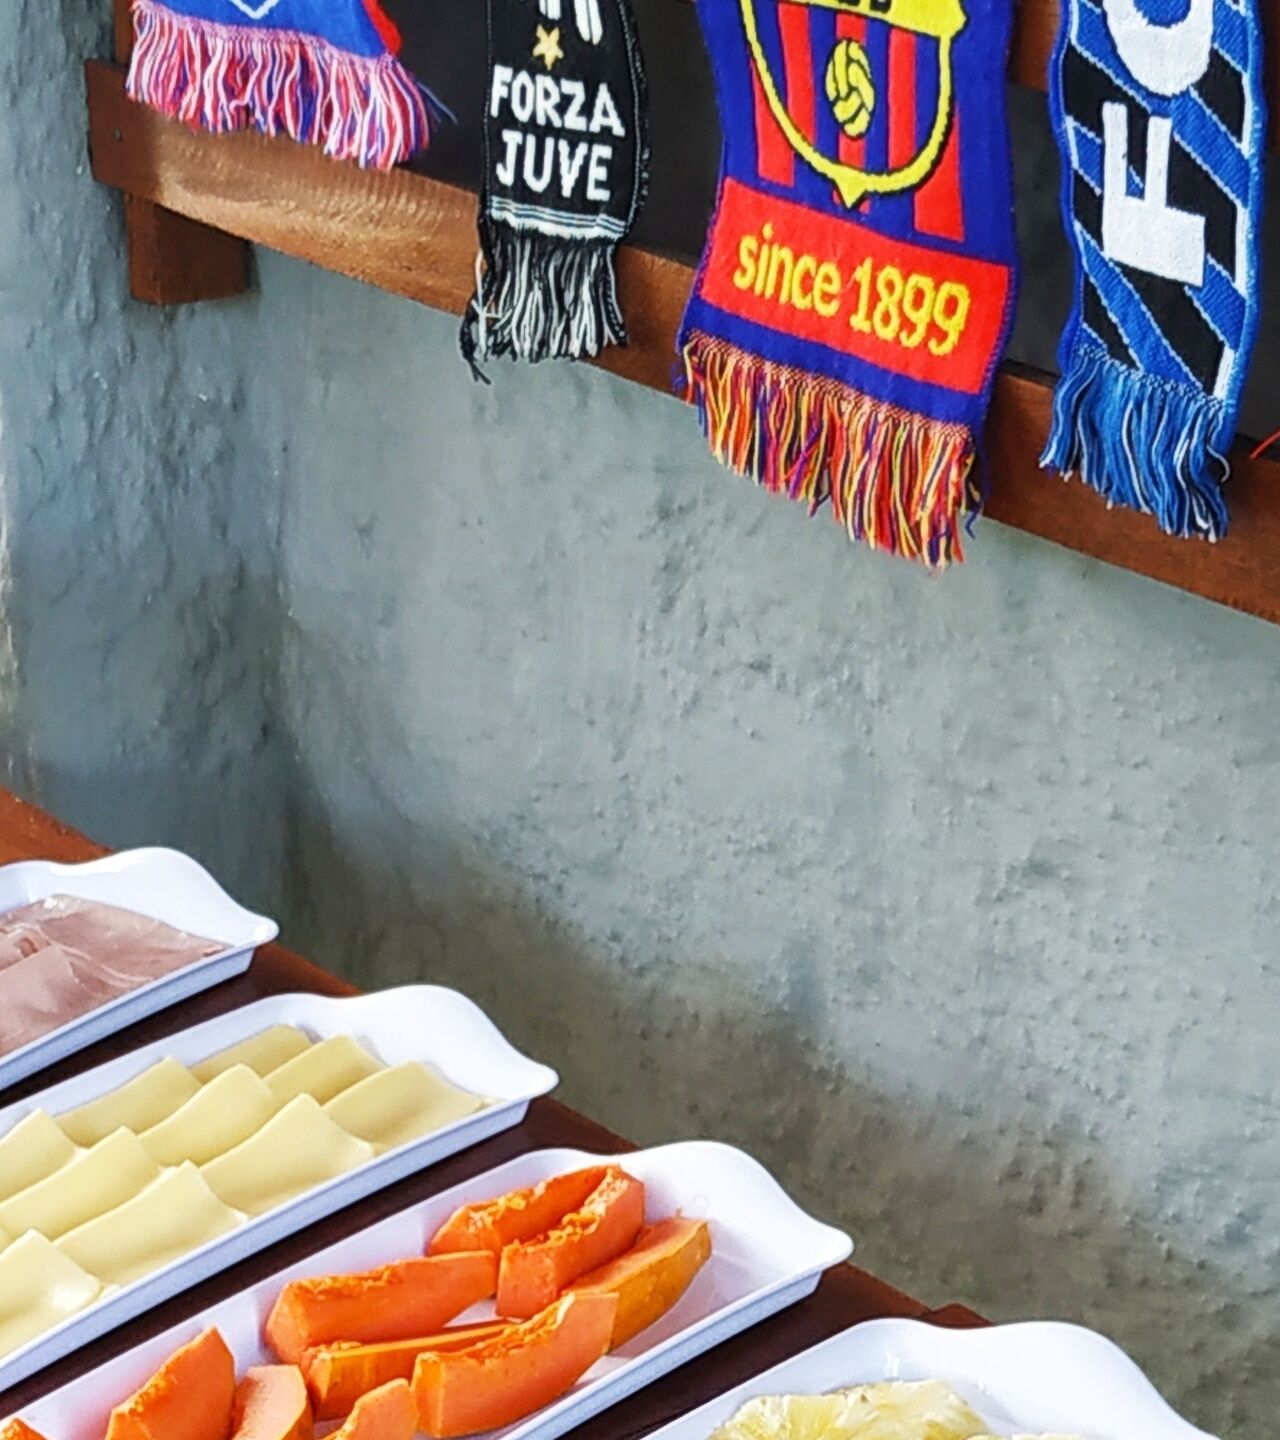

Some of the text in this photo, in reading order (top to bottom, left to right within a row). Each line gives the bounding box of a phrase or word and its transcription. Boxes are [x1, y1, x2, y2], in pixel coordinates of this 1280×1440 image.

[490, 64, 626, 137] FORZA
[495, 128, 613, 202] JUVE
[733, 222, 971, 356] since 1899
